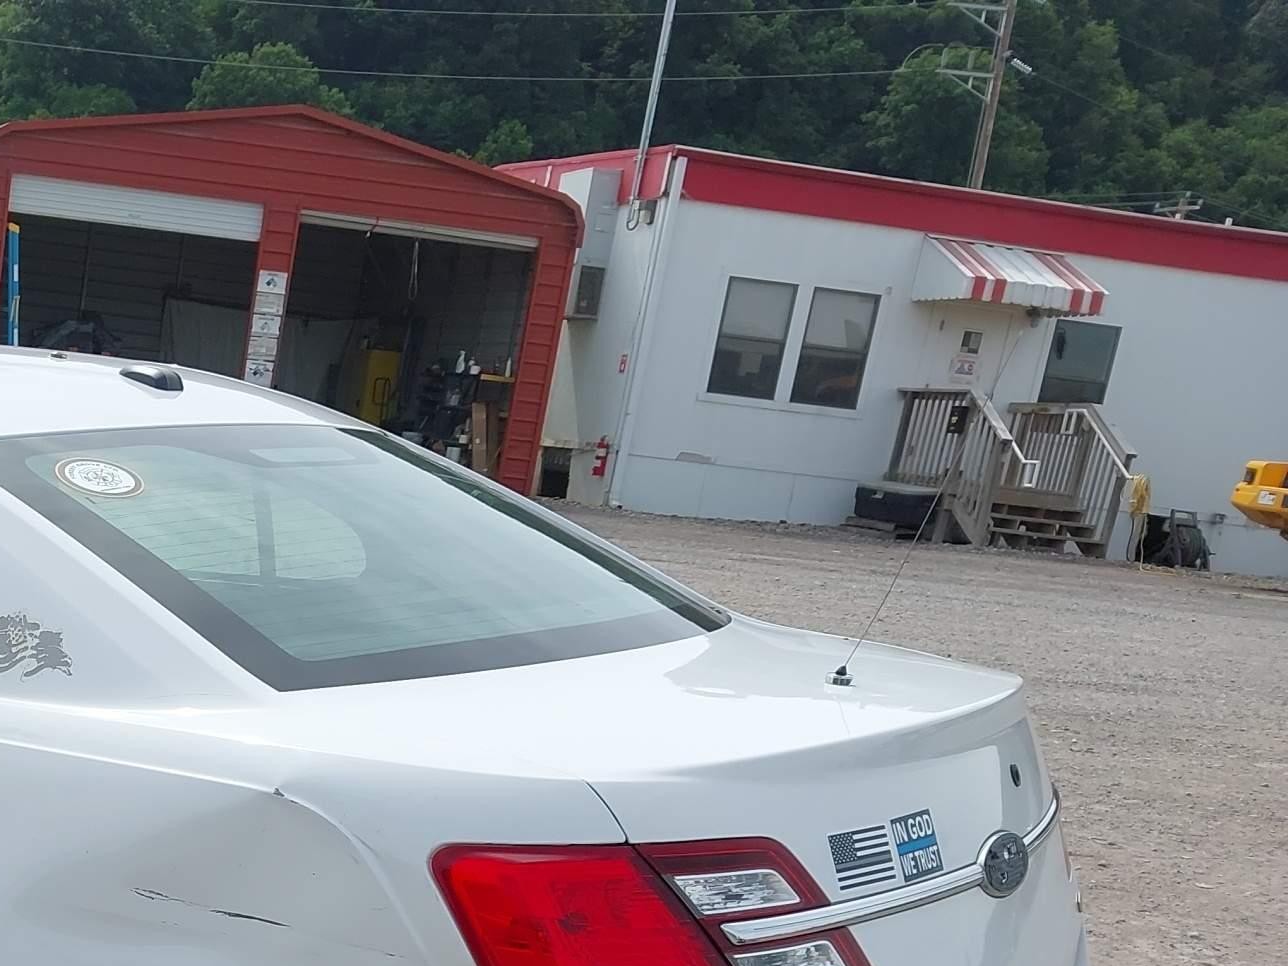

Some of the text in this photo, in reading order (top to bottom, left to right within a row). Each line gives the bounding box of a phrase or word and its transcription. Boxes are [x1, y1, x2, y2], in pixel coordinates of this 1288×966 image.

[892, 814, 933, 844] IN GOD
[900, 845, 942, 877] WE TRUST
